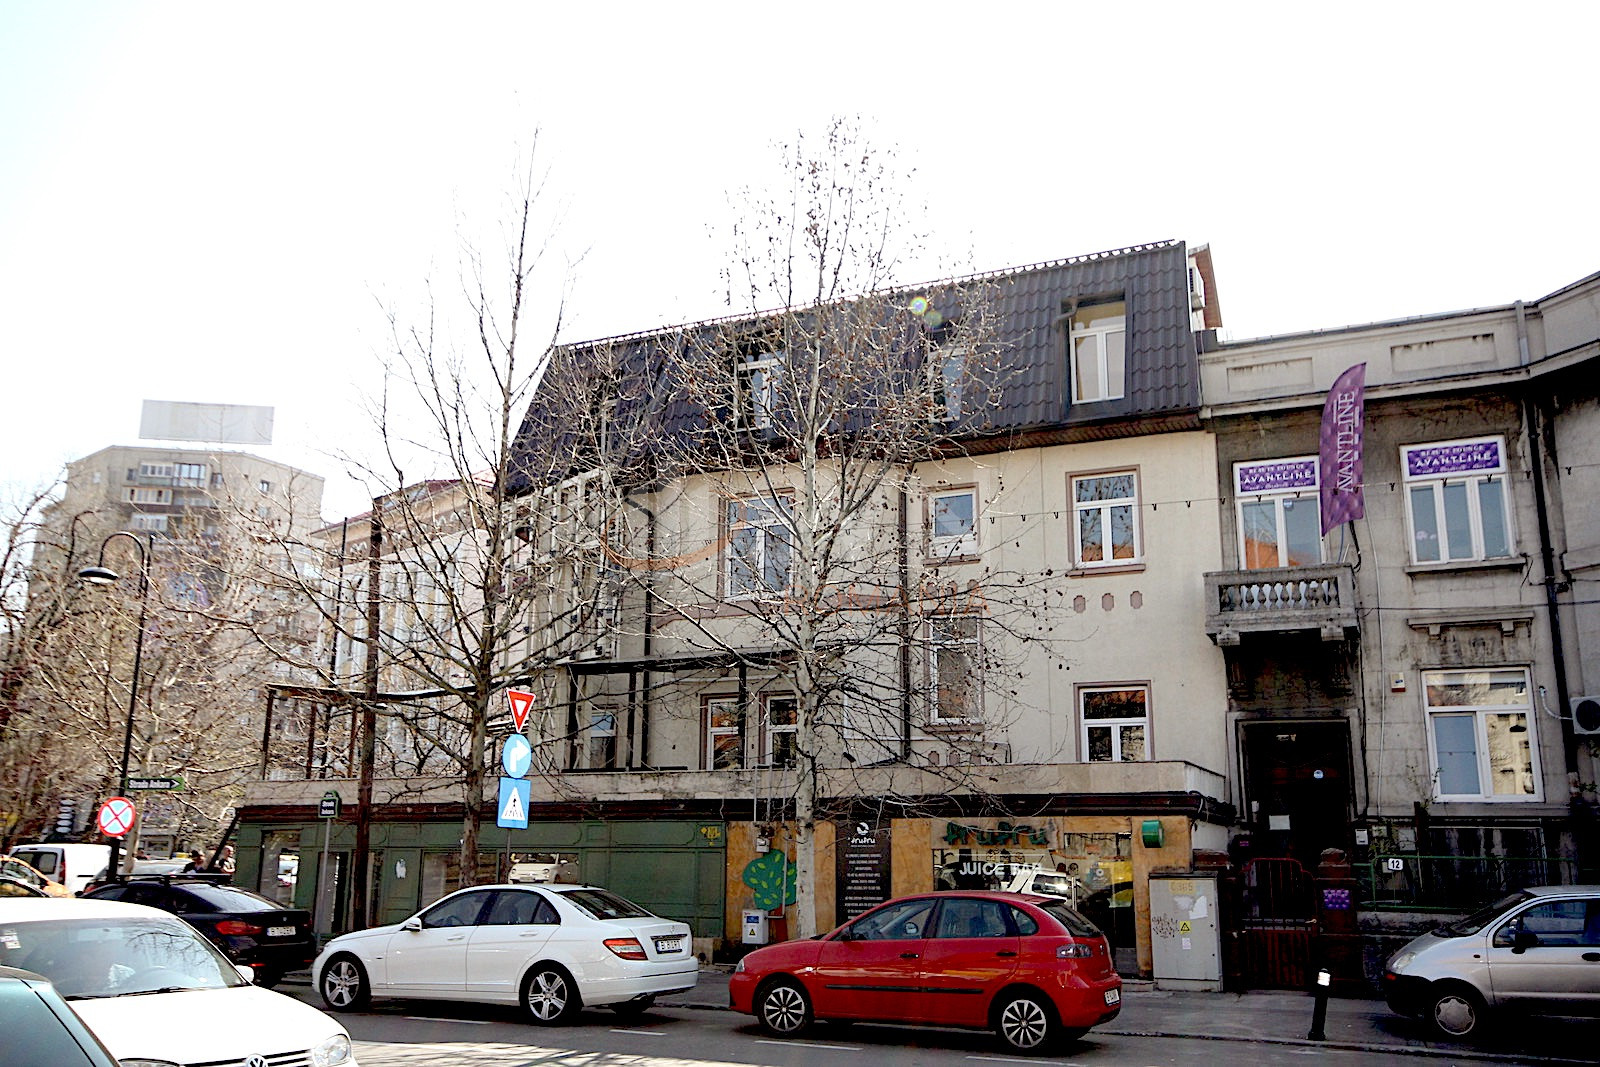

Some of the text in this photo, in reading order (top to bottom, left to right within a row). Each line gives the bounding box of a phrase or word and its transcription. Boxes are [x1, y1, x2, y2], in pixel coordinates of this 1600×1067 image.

[1336, 391, 1355, 494] AVANTLINE
[1415, 452, 1491, 467] AVANTLINE
[1244, 471, 1312, 484] AVANTLINE
[958, 861, 1006, 876] JUICE
[1390, 860, 1401, 869] 12
